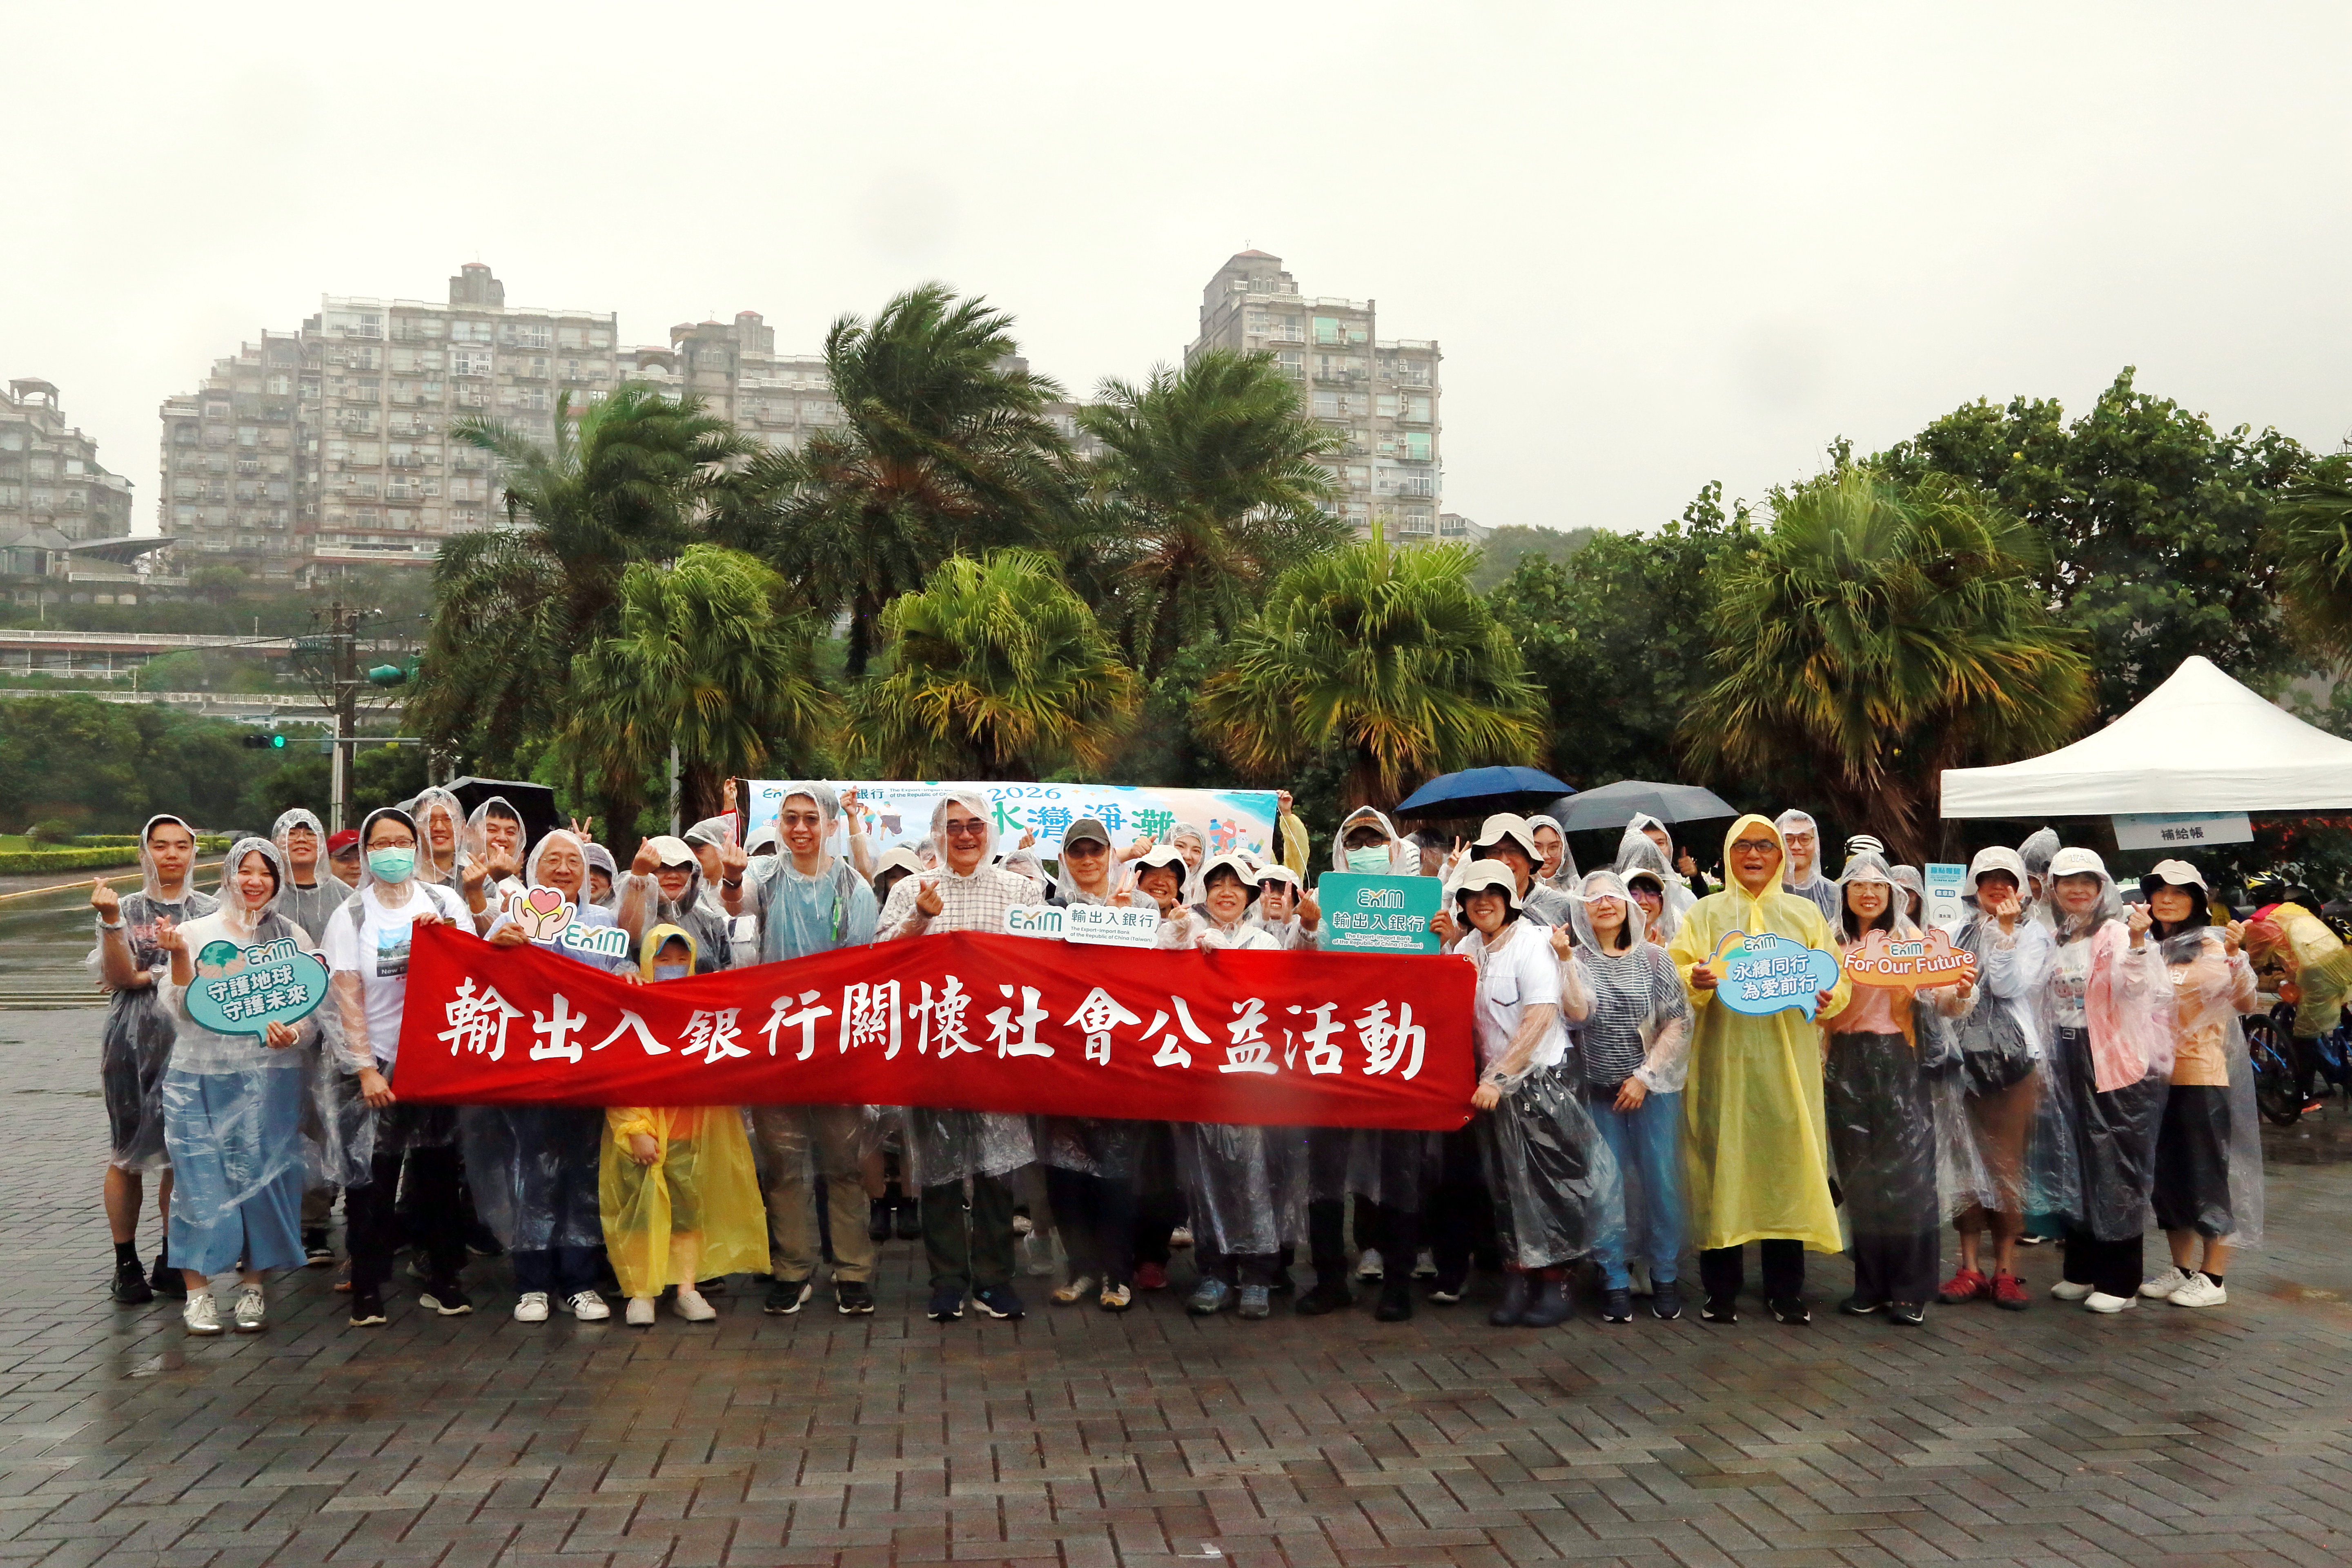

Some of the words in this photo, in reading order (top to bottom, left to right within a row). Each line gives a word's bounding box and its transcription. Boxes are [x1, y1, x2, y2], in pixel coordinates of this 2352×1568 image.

[987, 787, 1061, 802] 2026
[2160, 827, 2204, 841] 補給帳
[1071, 909, 1154, 928] 輸出入銀行
[1333, 912, 1425, 932] 輸出入銀行
[1733, 954, 1809, 981] 永續同行
[1844, 954, 1875, 972] For
[1878, 958, 1912, 973] Our
[1916, 953, 1974, 973] Future
[207, 964, 294, 1001] 守護地球
[1741, 974, 1817, 1000] 為愛前行
[222, 984, 308, 1020] 守護未來
[437, 975, 1426, 1080] 輸出入銀行關懷社會公益活動
